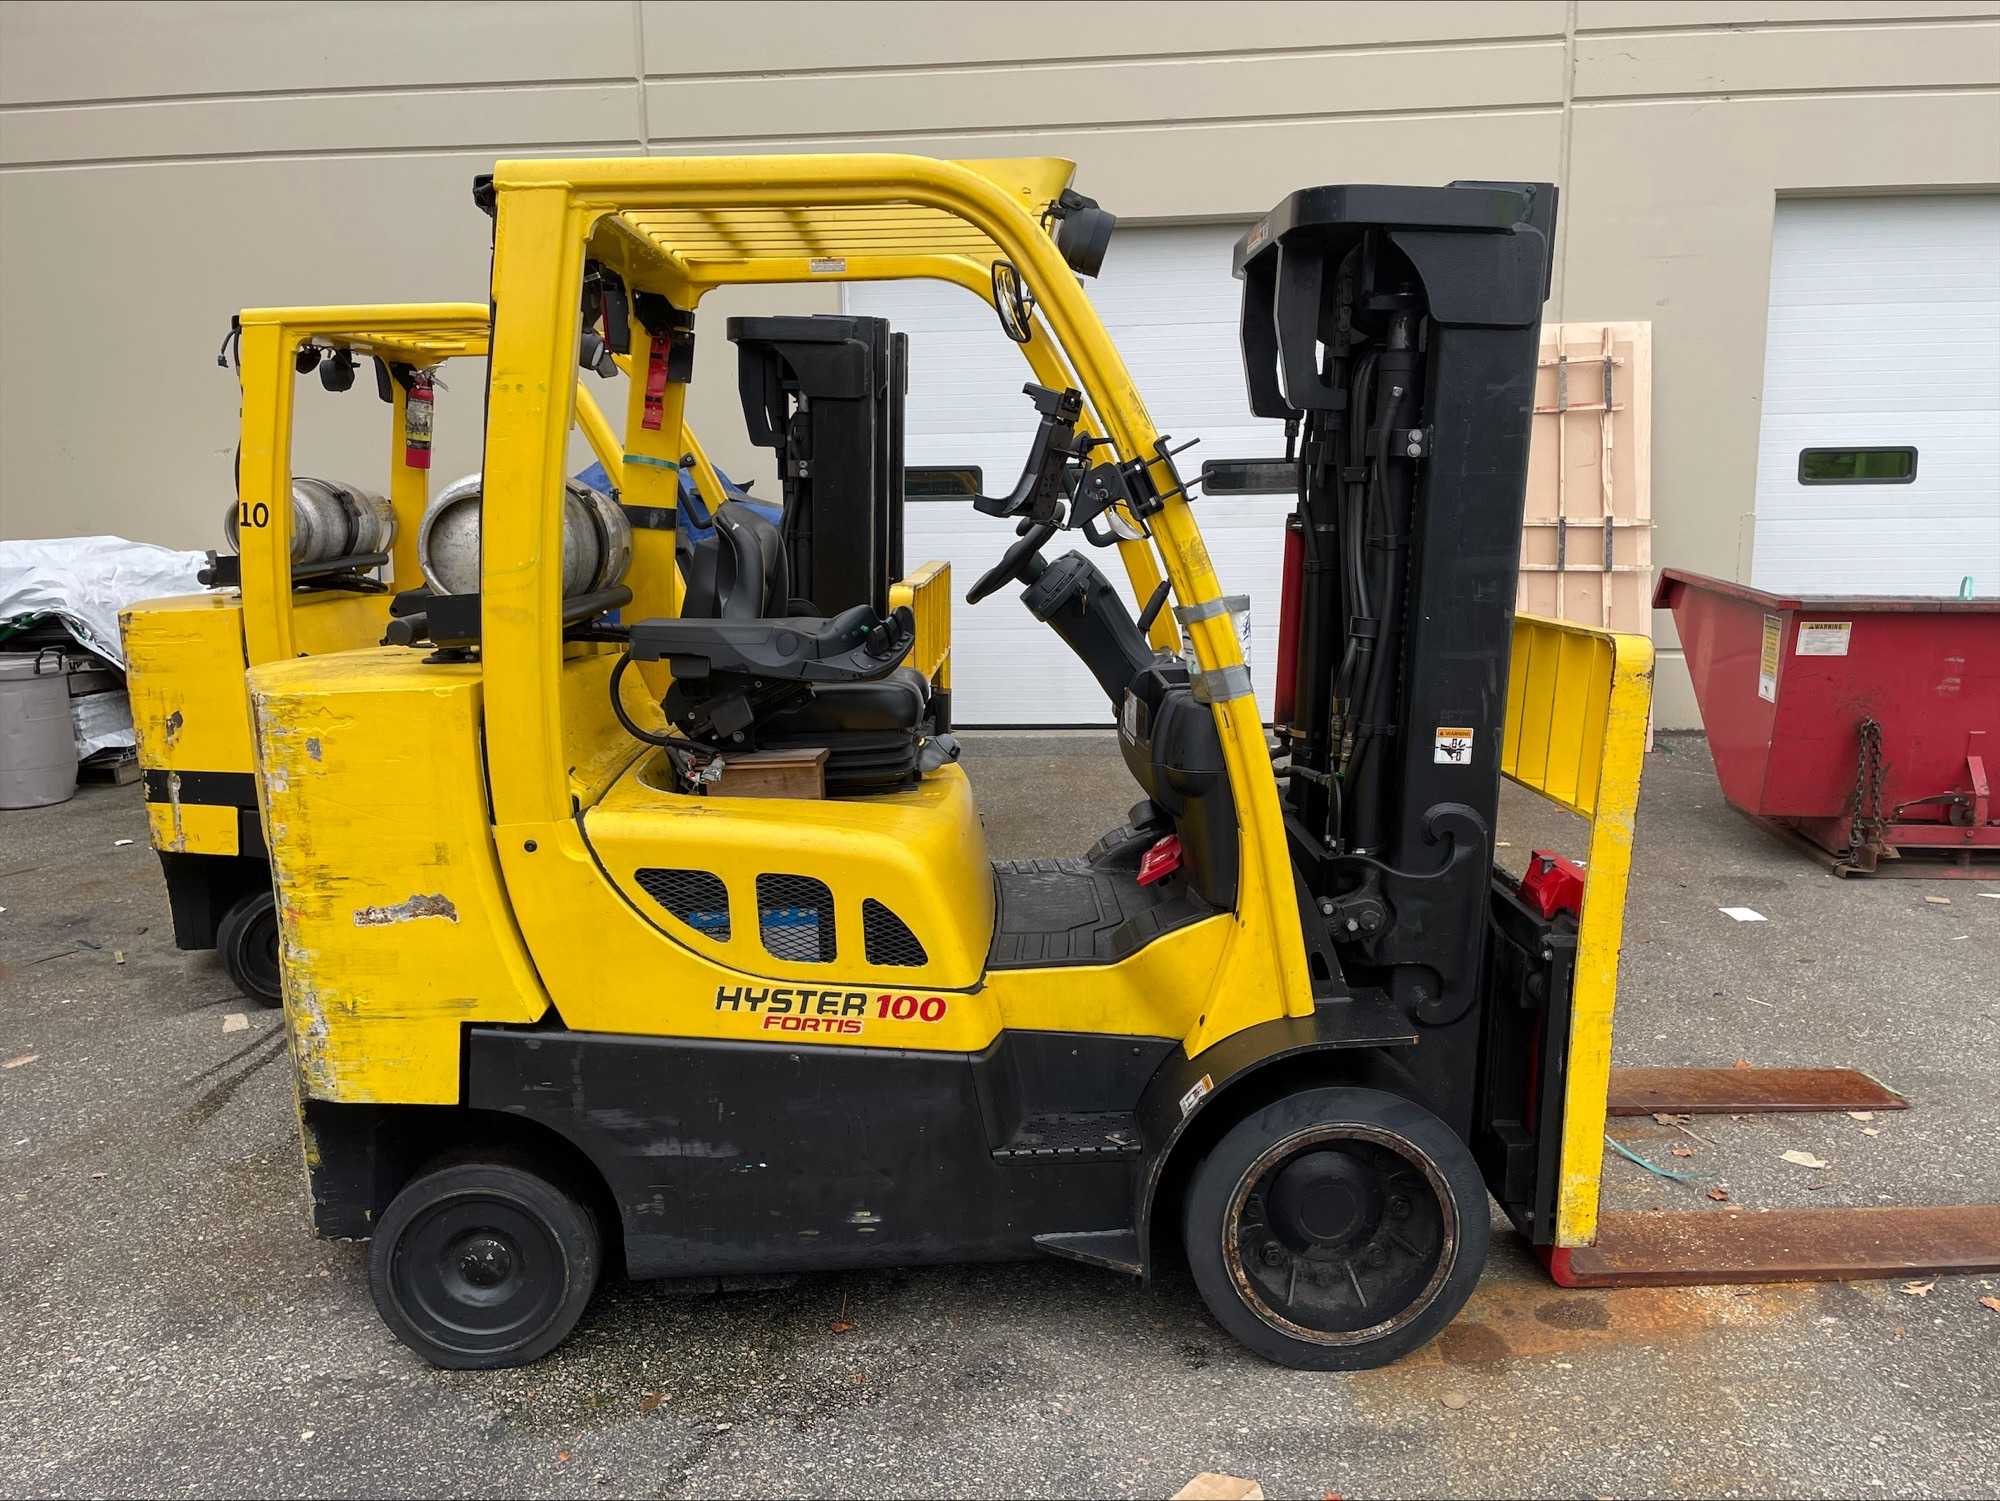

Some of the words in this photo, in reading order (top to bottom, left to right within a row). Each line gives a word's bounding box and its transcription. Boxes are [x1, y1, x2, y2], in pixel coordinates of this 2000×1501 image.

[240, 502, 269, 528] 10
[716, 986, 867, 1016] HYSTER
[877, 994, 946, 1021] 100
[763, 1015, 862, 1033] FORTIS
